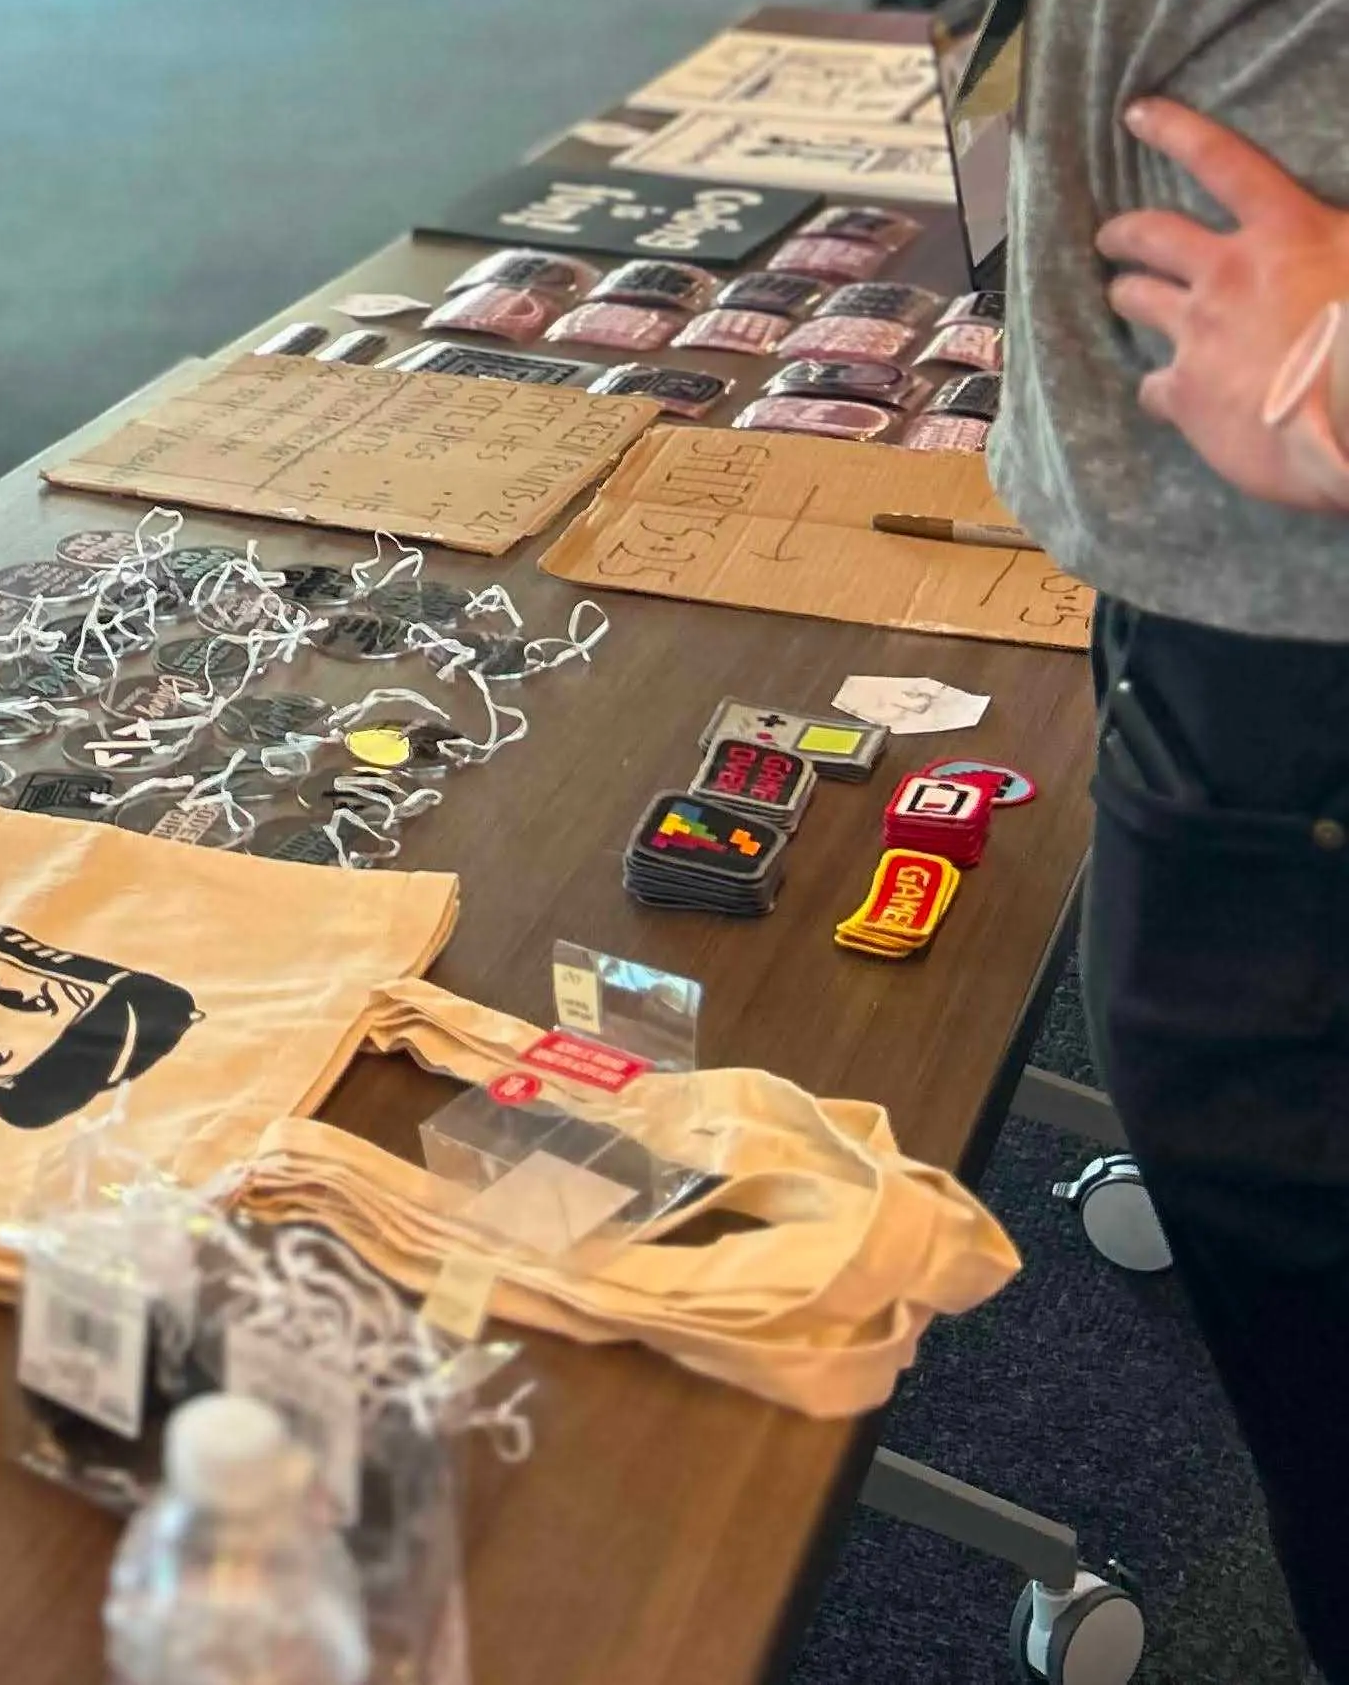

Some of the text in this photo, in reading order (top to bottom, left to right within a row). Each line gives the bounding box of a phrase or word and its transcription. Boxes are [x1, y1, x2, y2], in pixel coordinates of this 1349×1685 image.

[443, 385, 518, 421] TOTE
[476, 391, 578, 462] PATCHES
[554, 397, 639, 457] SCREEN
[404, 422, 476, 461] BAGS
[709, 746, 757, 794] OVER
[750, 755, 793, 803] GAME
[879, 865, 932, 927] GAME
